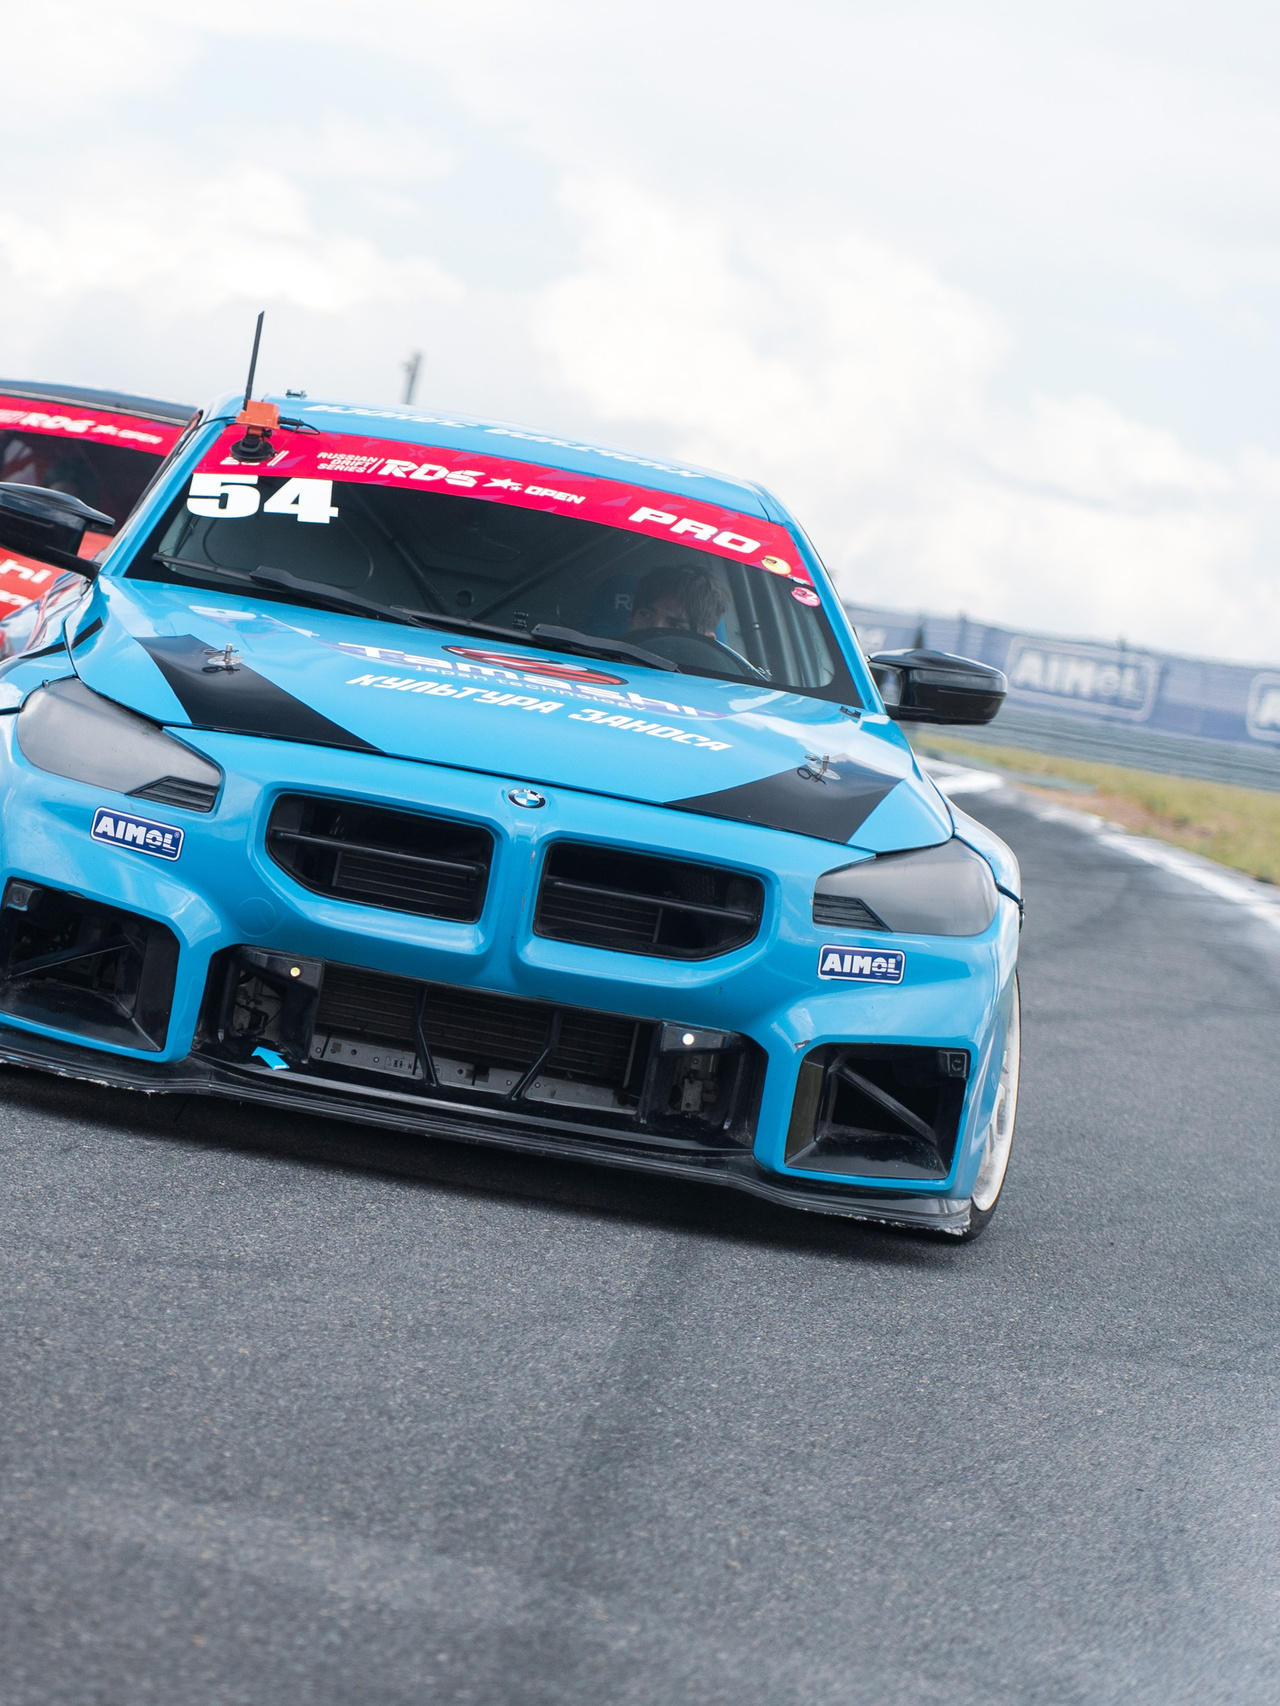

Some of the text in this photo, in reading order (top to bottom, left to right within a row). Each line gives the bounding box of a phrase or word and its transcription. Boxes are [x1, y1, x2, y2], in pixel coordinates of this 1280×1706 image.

[316, 452, 378, 463] RUSSIAN
[316, 463, 367, 473] SERIES
[330, 459, 373, 467] DRIFT
[186, 473, 339, 524] 54
[377, 459, 586, 504] RDS OPEN
[628, 506, 761, 554] PRO
[338, 642, 699, 717] Tamashi
[496, 678, 646, 711] technology
[345, 674, 733, 751] КУЛЬТУРА ЗАНОСА
[95, 816, 177, 854] AIMOL
[821, 953, 900, 978] AIMOL
